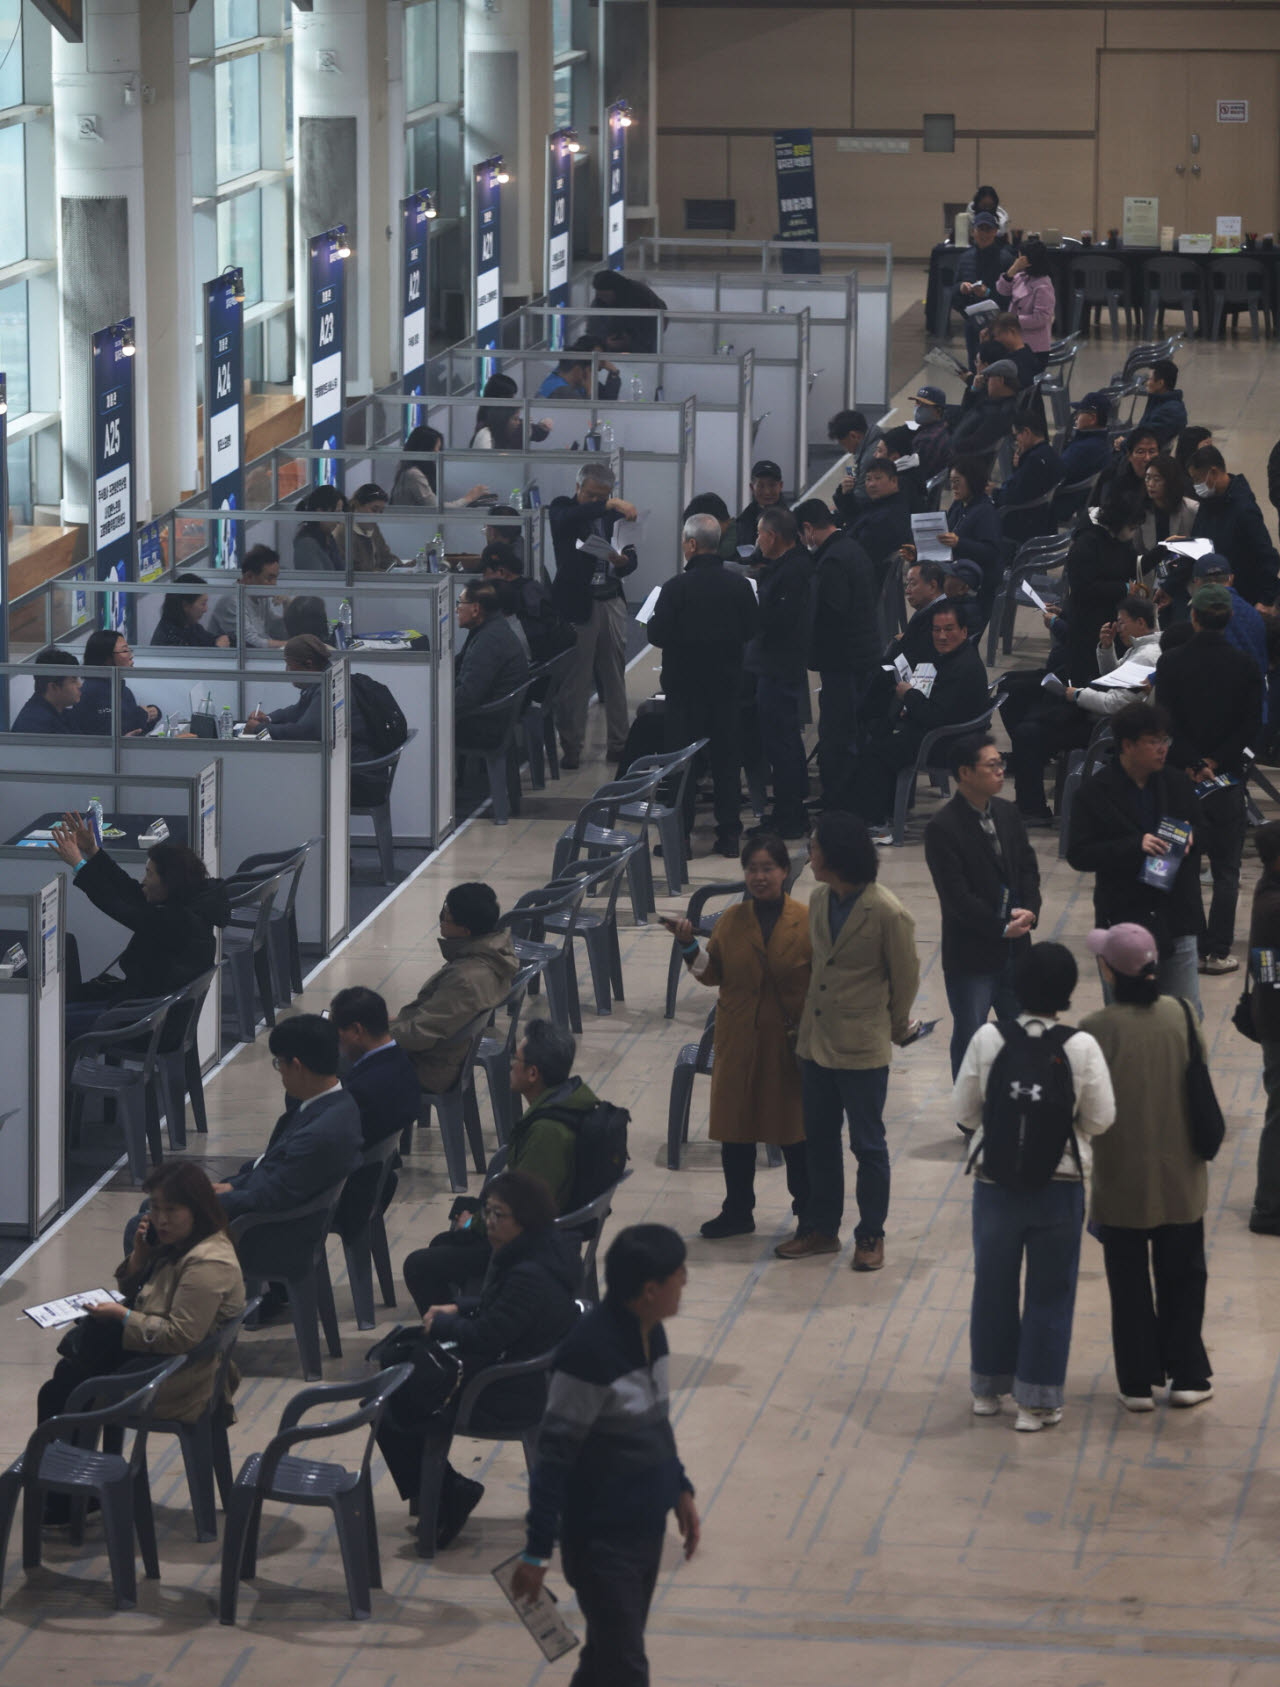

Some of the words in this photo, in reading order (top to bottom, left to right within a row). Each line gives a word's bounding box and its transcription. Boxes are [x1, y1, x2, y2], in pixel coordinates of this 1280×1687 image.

[482, 231, 494, 262] A21
[408, 270, 420, 302] A22
[319, 312, 334, 347] A23
[216, 361, 232, 399] A24
[103, 417, 121, 459] A25
